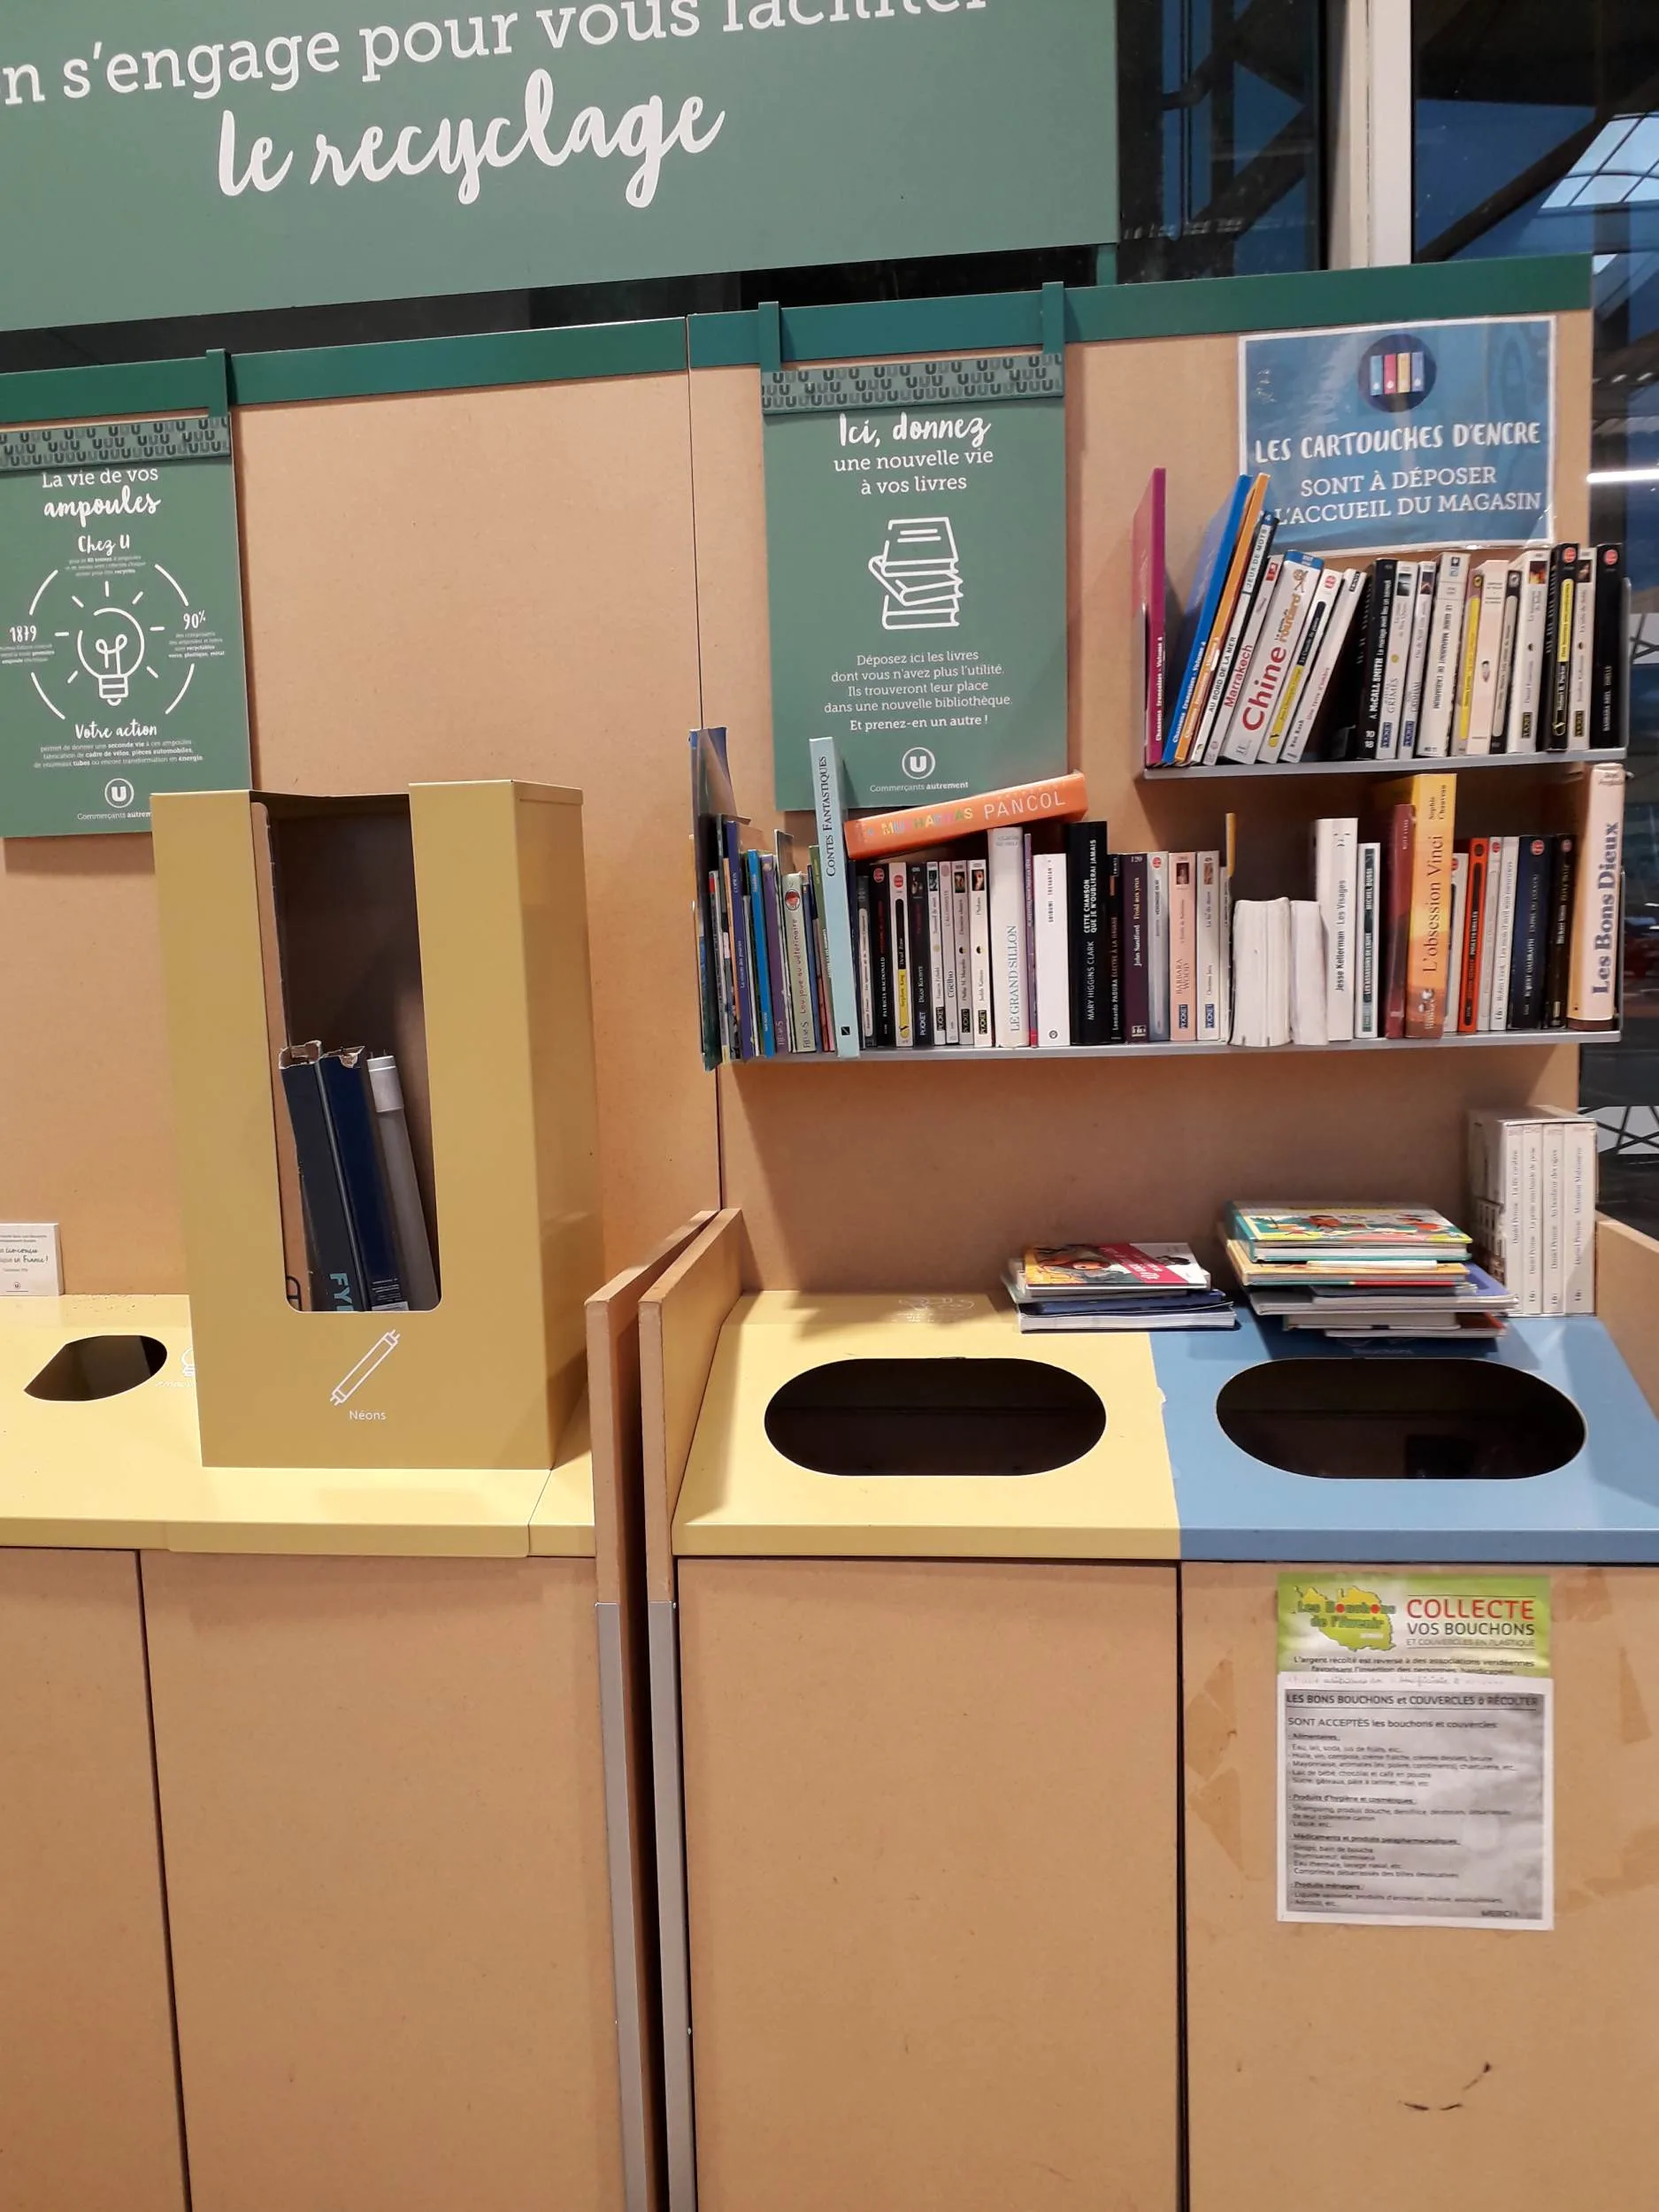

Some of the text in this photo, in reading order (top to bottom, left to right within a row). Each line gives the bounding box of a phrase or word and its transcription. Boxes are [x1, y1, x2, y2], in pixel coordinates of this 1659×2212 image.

[63, 32, 340, 99] s'engage
[359, 12, 518, 82] pour
[536, 0, 699, 48] vous
[219, 68, 726, 208] le recyclage
[840, 411, 991, 448] Ici, donnez
[1255, 421, 1541, 464] LES CARTOUCHES D'ENCRE
[833, 448, 994, 472] une nouvelle vie
[42, 468, 158, 488] La vie de vos
[861, 476, 967, 495] à vos livres
[1301, 466, 1497, 497] SONT À DÉPOSER
[44, 485, 161, 527] ampoules
[1276, 500, 1391, 526] L'ACCUEIL
[1398, 496, 1432, 516] DU
[1438, 492, 1541, 513] MAGASIN
[78, 534, 116, 557] Chez
[1245, 567, 1256, 588] JEUX
[1251, 554, 1260, 565] DE
[1256, 528, 1267, 550] MOTS
[183, 610, 205, 630] 90%
[10, 625, 36, 642] 1879
[856, 650, 979, 667] Déposez ici les livres
[831, 671, 858, 682] dont
[861, 671, 890, 680] vous
[893, 668, 930, 680] n'avez
[933, 666, 958, 680] plus
[1207, 636, 1237, 712] AU BORD DE LA MER
[1224, 644, 1254, 707] Marrakech
[1370, 658, 1383, 711] McCALL SMITH
[848, 680, 989, 697] Ils trouveront leur place
[1242, 647, 1286, 731] Chine
[824, 703, 853, 713] dans
[856, 702, 879, 711] une
[881, 698, 933, 710] nouvelle
[74, 718, 157, 740] Votre action
[849, 720, 862, 731] Et
[864, 718, 928, 733] prenez-en
[931, 717, 948, 726] un
[949, 715, 982, 726] autre
[1172, 713, 1186, 743] Chansons
[910, 755, 927, 772] U
[870, 781, 969, 794] Commerçants autrement
[817, 756, 837, 877] CONTES FANTASTIQUES
[983, 790, 1067, 821] PANCOL
[1336, 880, 1347, 910] Visages
[1422, 835, 1444, 973] L'obsession Vinci
[1592, 822, 1619, 995] Les Bons Dieux
[1335, 931, 1345, 969] Kellerman
[1007, 925, 1020, 1032] LE GRAND SILLON
[1335, 971, 1345, 992] Jesse
[1087, 998, 1095, 1020] MARY
[349, 1410, 386, 1421] Néons
[1407, 1599, 1535, 1620] COLLECTE
[1407, 1623, 1535, 1635] VOS BOUCHONS
[1286, 1694, 1304, 1703] LES
[1307, 1694, 1334, 1703] BONS
[1337, 1695, 1394, 1704] BOUCHONS
[1409, 1695, 1475, 1705] COUVERCLES
[1288, 1717, 1316, 1726] SONT
[1318, 1717, 1370, 1727] ACCEPTÉS
